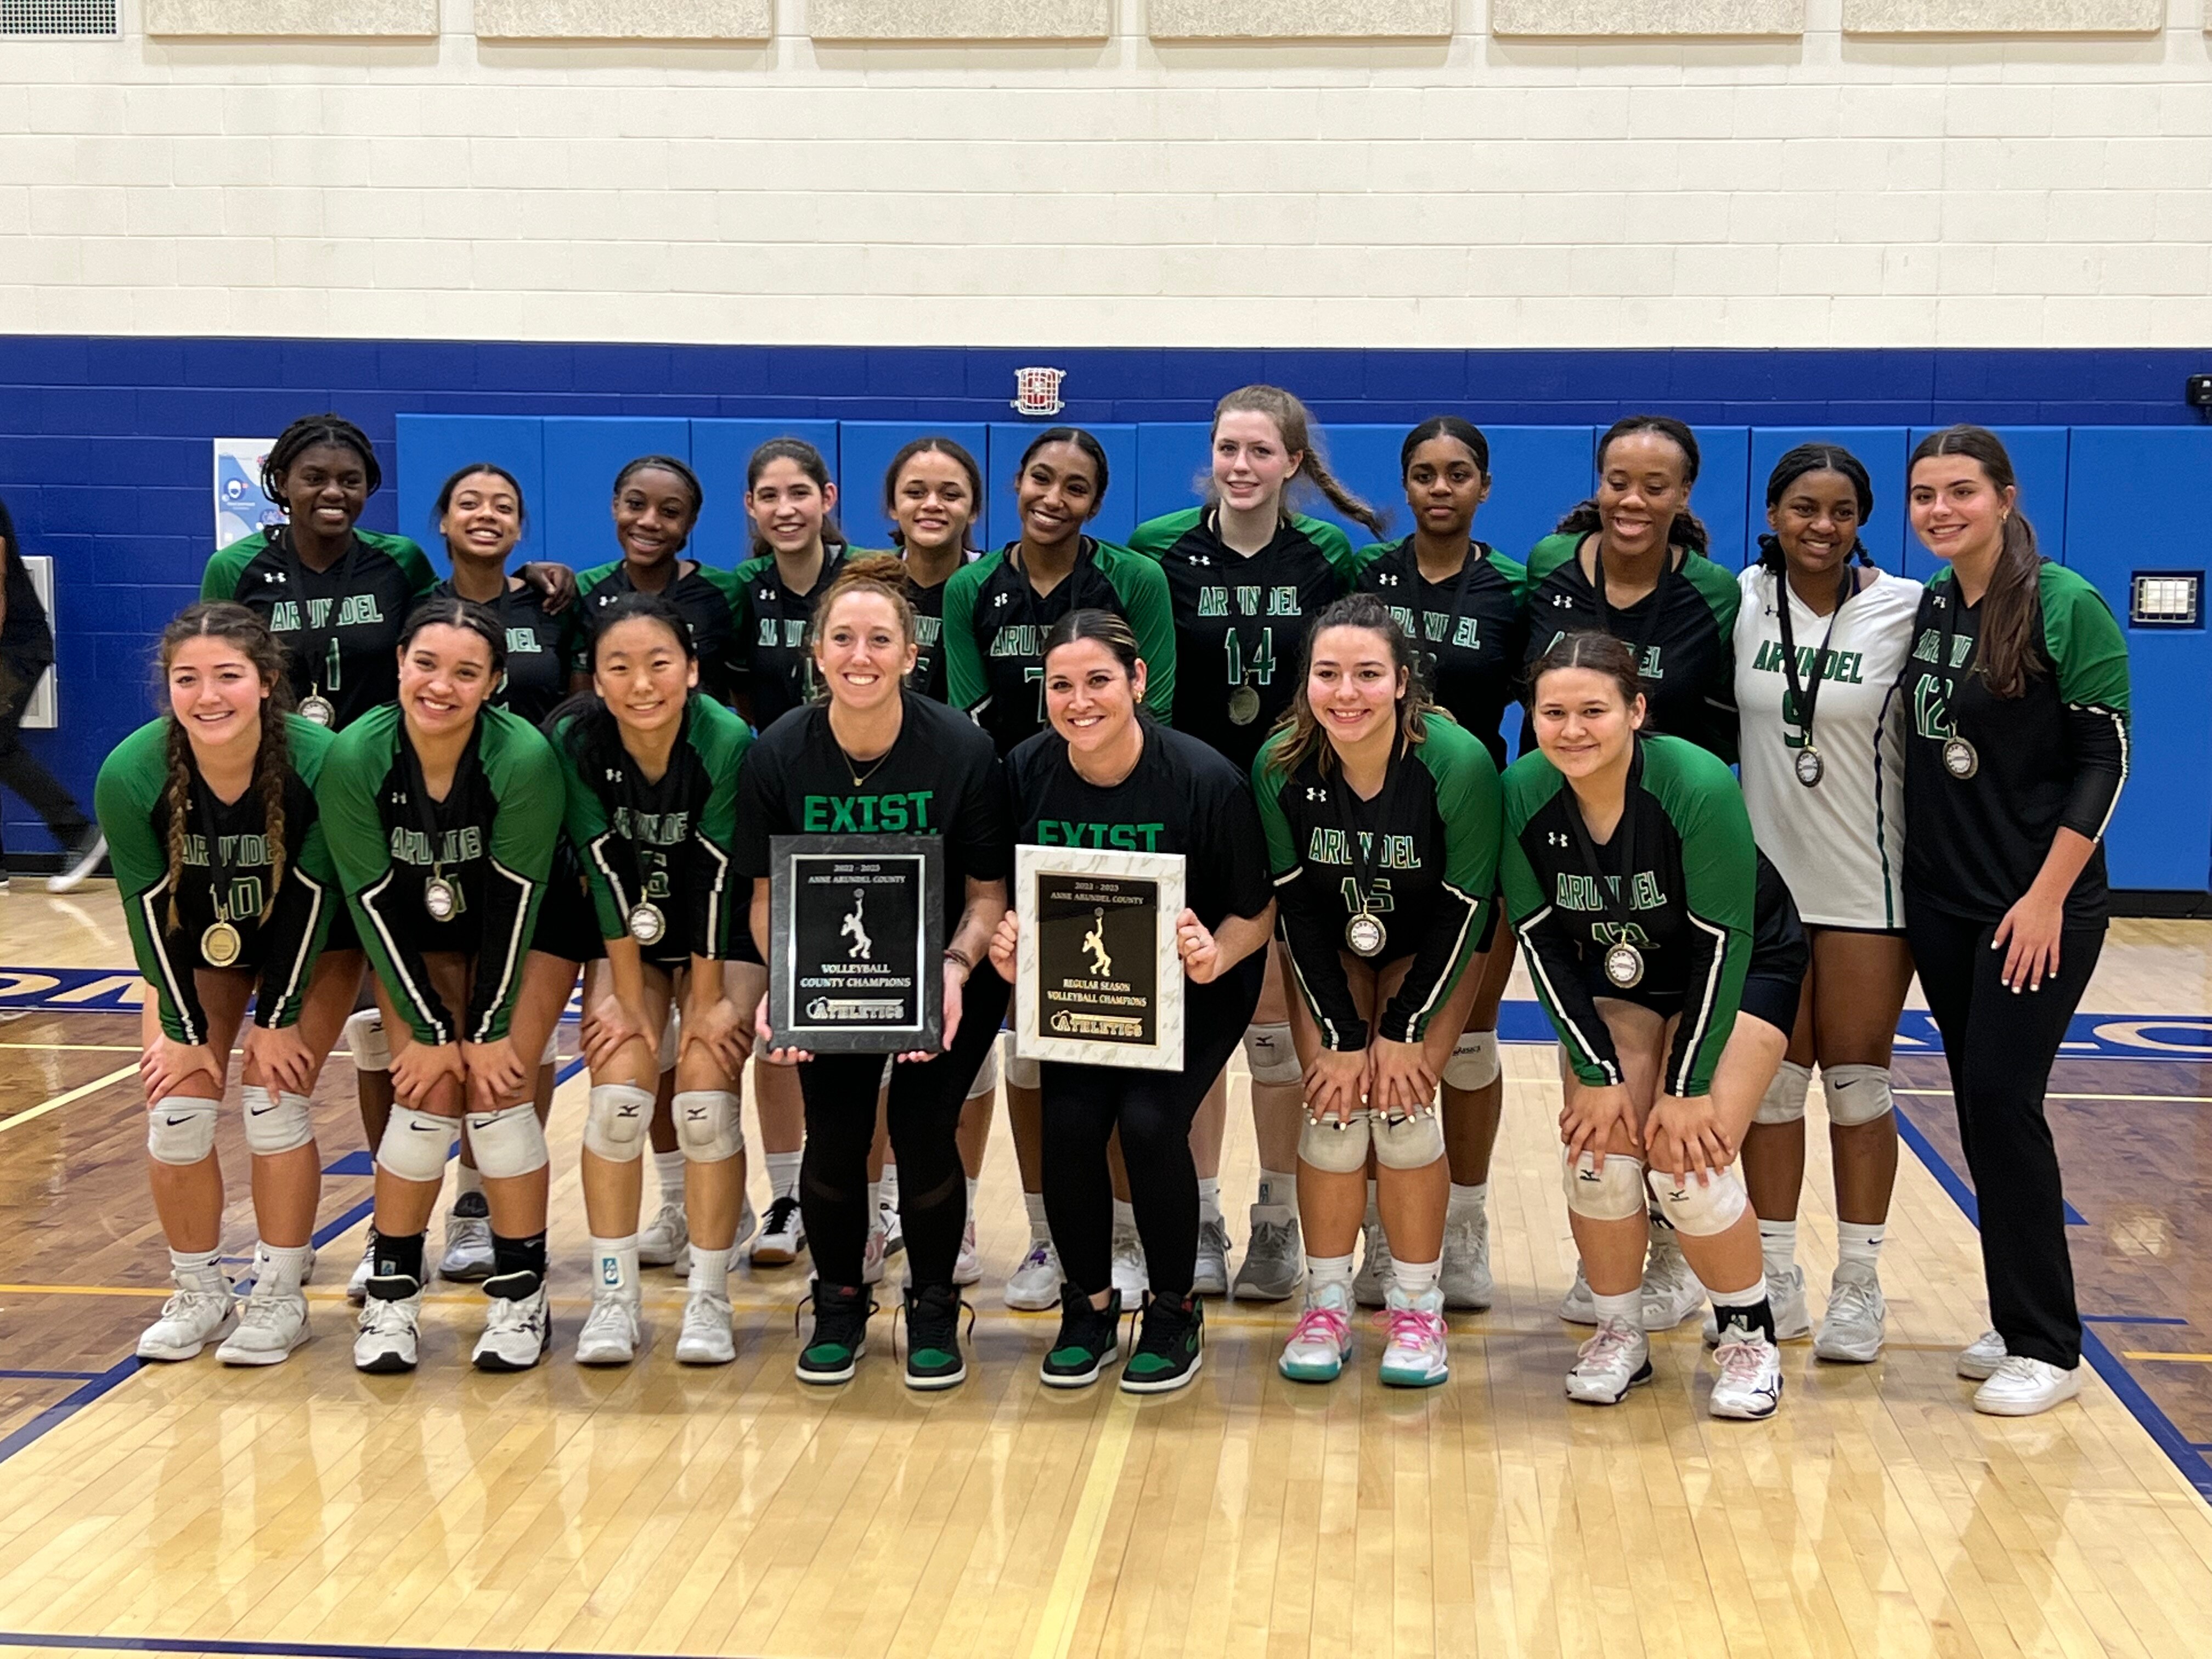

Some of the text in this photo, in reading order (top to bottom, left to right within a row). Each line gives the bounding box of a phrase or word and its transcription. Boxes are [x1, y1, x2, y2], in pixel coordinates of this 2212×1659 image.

[1384, 605, 1480, 650] RUNEL
[325, 637, 341, 691] 1
[1224, 628, 1276, 685] 14
[1914, 673, 1954, 741] 12
[804, 791, 933, 832] EXIST
[1038, 819, 1164, 854] EXIST
[832, 876, 871, 884] ARUNDEL
[872, 876, 906, 884] COUNTY
[1340, 877, 1395, 913] 15
[1074, 893, 1111, 903] ARUNDEL
[1112, 895, 1144, 905] COUNTY
[799, 978, 912, 988] COUNTY CHAMPIONS
[821, 964, 891, 974] VOLLEYBALL
[1063, 978, 1131, 993] REGULAR SEASON
[1047, 990, 1148, 1008] VOLLEYBALL CHAMPIONS
